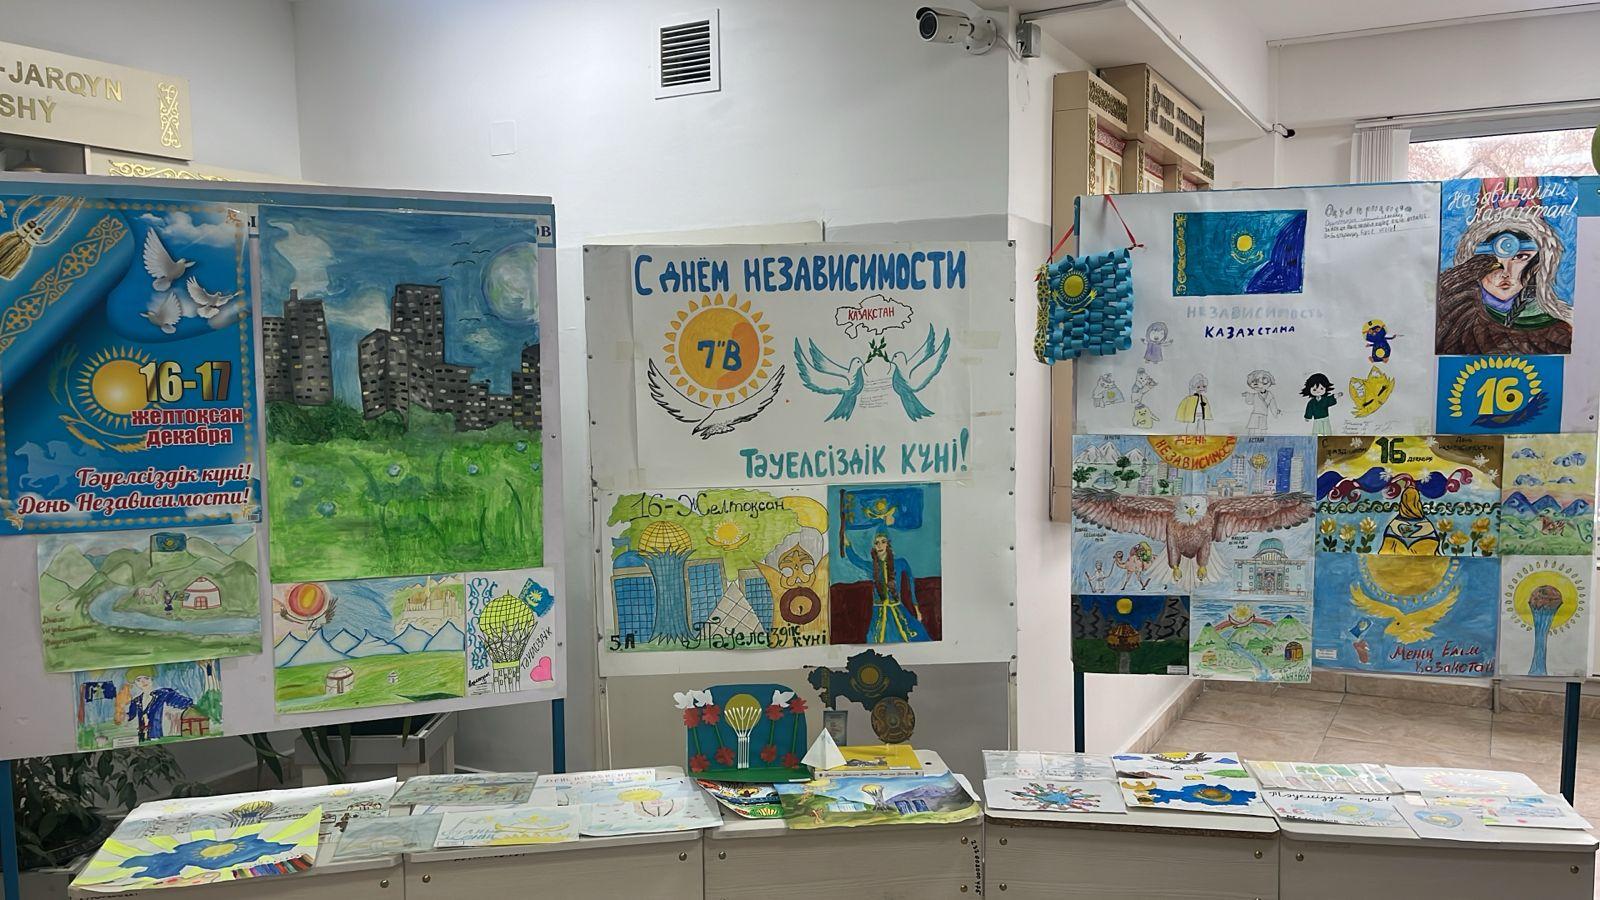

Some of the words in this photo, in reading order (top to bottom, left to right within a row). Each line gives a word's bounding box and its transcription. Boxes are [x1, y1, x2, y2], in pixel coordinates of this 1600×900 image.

[634, 254, 653, 296] С
[659, 259, 729, 294] ДНЁМ
[744, 250, 967, 293] НЕЗАВИСИМОСТИ
[1204, 325, 1296, 339] КАЗАХСТАНА
[140, 361, 231, 402] 16-17
[1476, 376, 1523, 416] 16
[146, 426, 233, 448] декабря
[1375, 436, 1407, 464] 16
[17, 495, 70, 515] День
[75, 488, 250, 517] Независимости!
